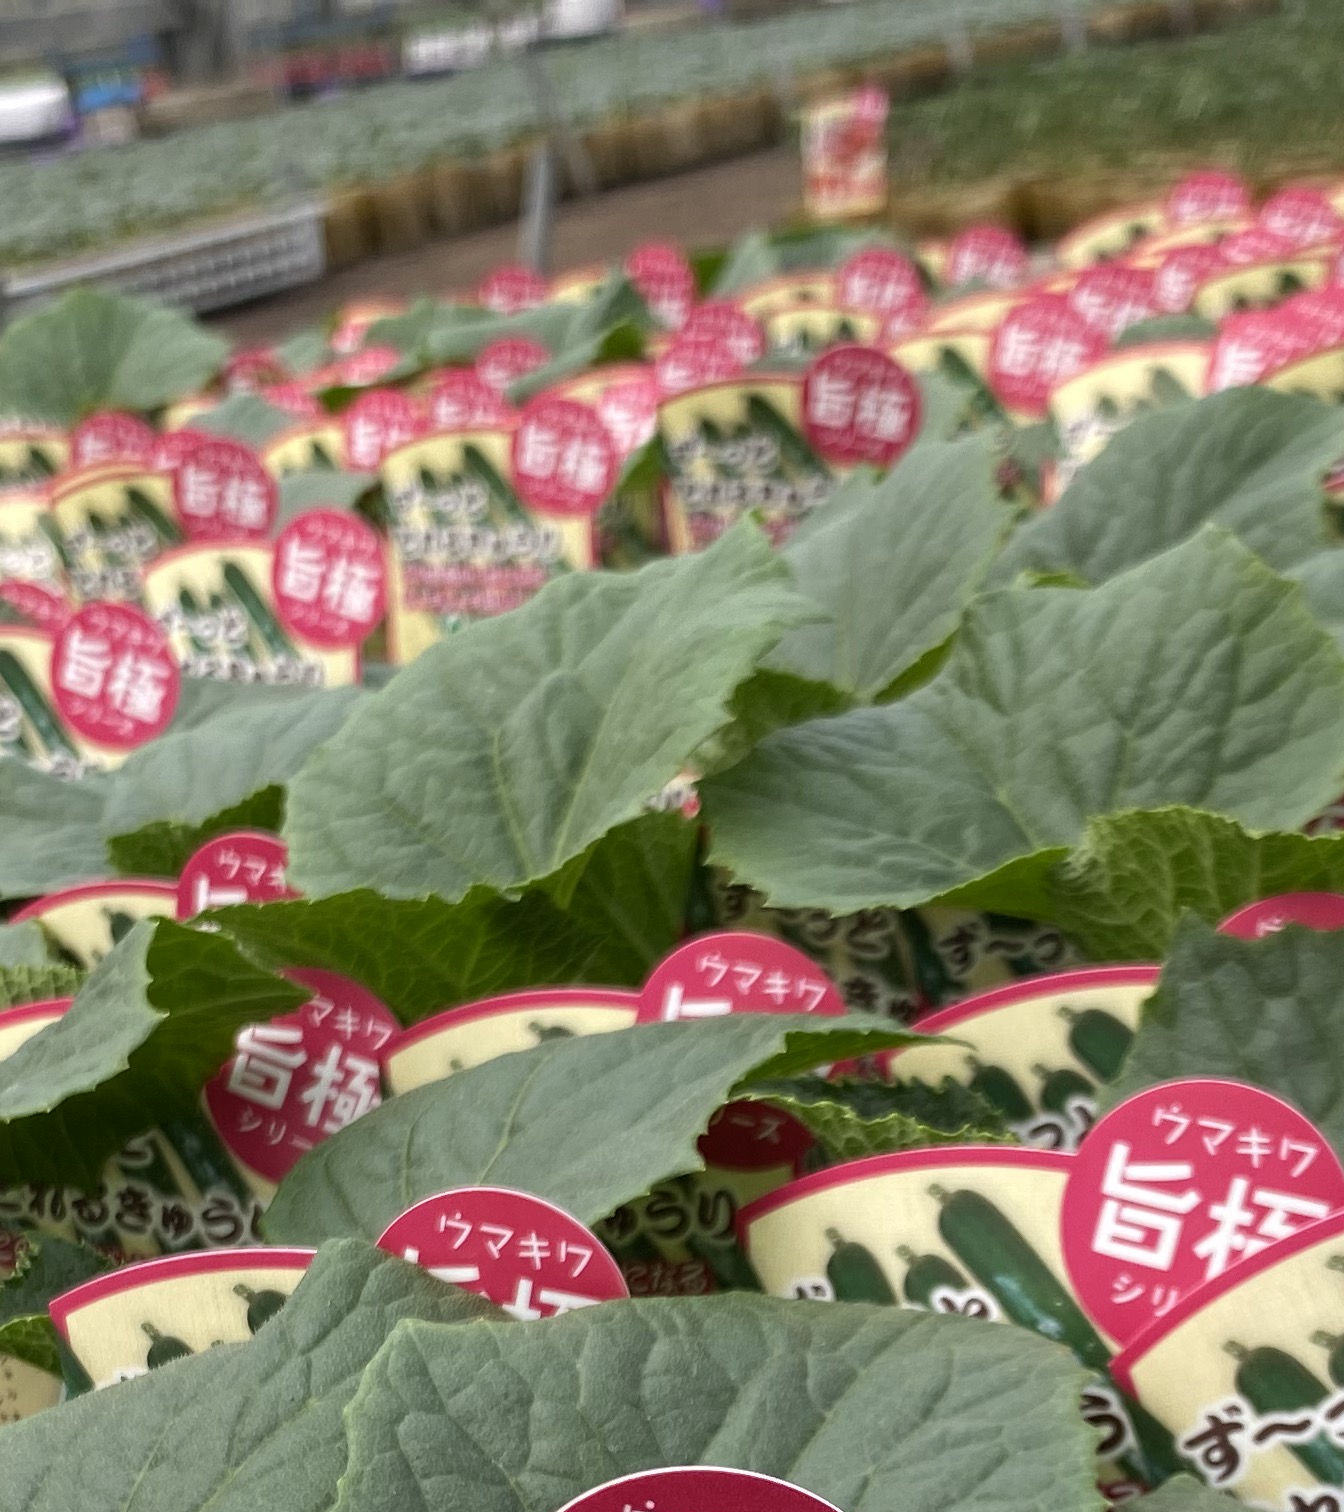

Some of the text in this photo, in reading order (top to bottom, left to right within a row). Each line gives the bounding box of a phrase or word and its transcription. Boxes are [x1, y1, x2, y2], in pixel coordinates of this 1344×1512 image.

[57, 628, 170, 723] 旨極
[696, 953, 827, 1011] ウマキワ
[228, 1023, 382, 1134] 旨極
[1152, 1104, 1319, 1178] ウマキワ
[439, 1212, 593, 1278] ウマキワ
